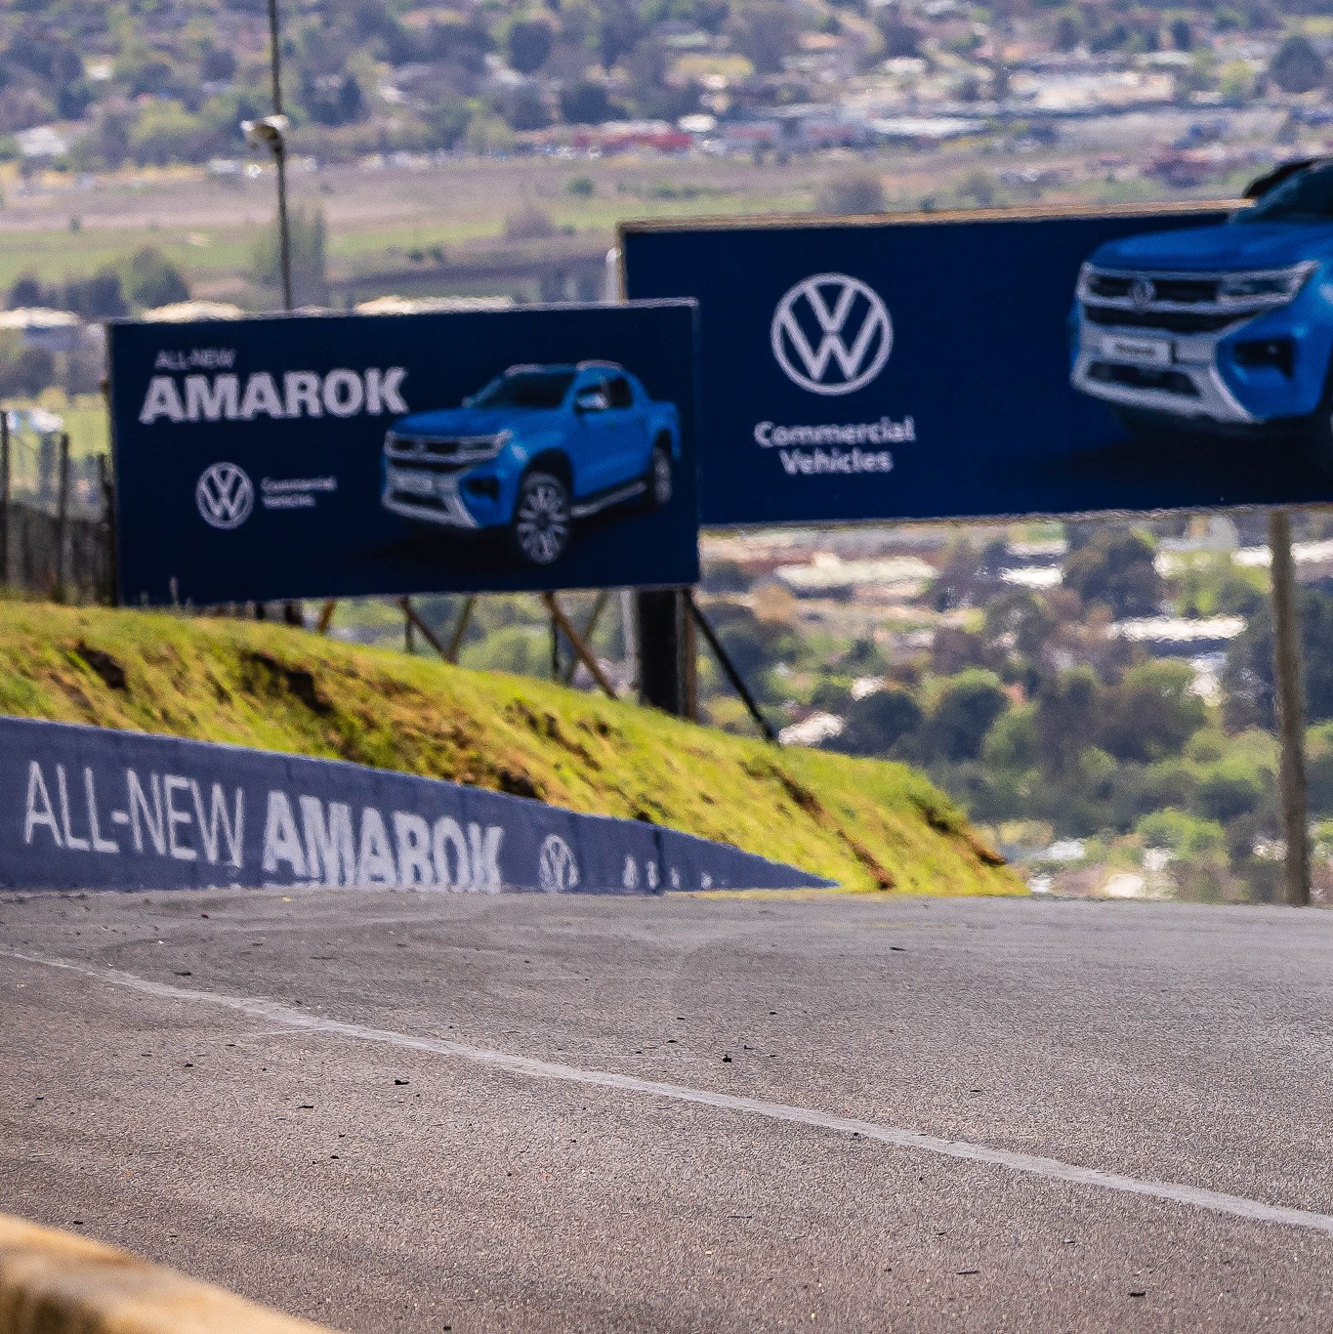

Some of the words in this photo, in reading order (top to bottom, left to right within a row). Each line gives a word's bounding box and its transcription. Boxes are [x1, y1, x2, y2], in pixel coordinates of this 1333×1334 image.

[139, 367, 410, 424] AMAROK
[754, 416, 916, 448] Commercial
[779, 447, 894, 475] Vehicles
[24, 760, 244, 868] ALL-NEW
